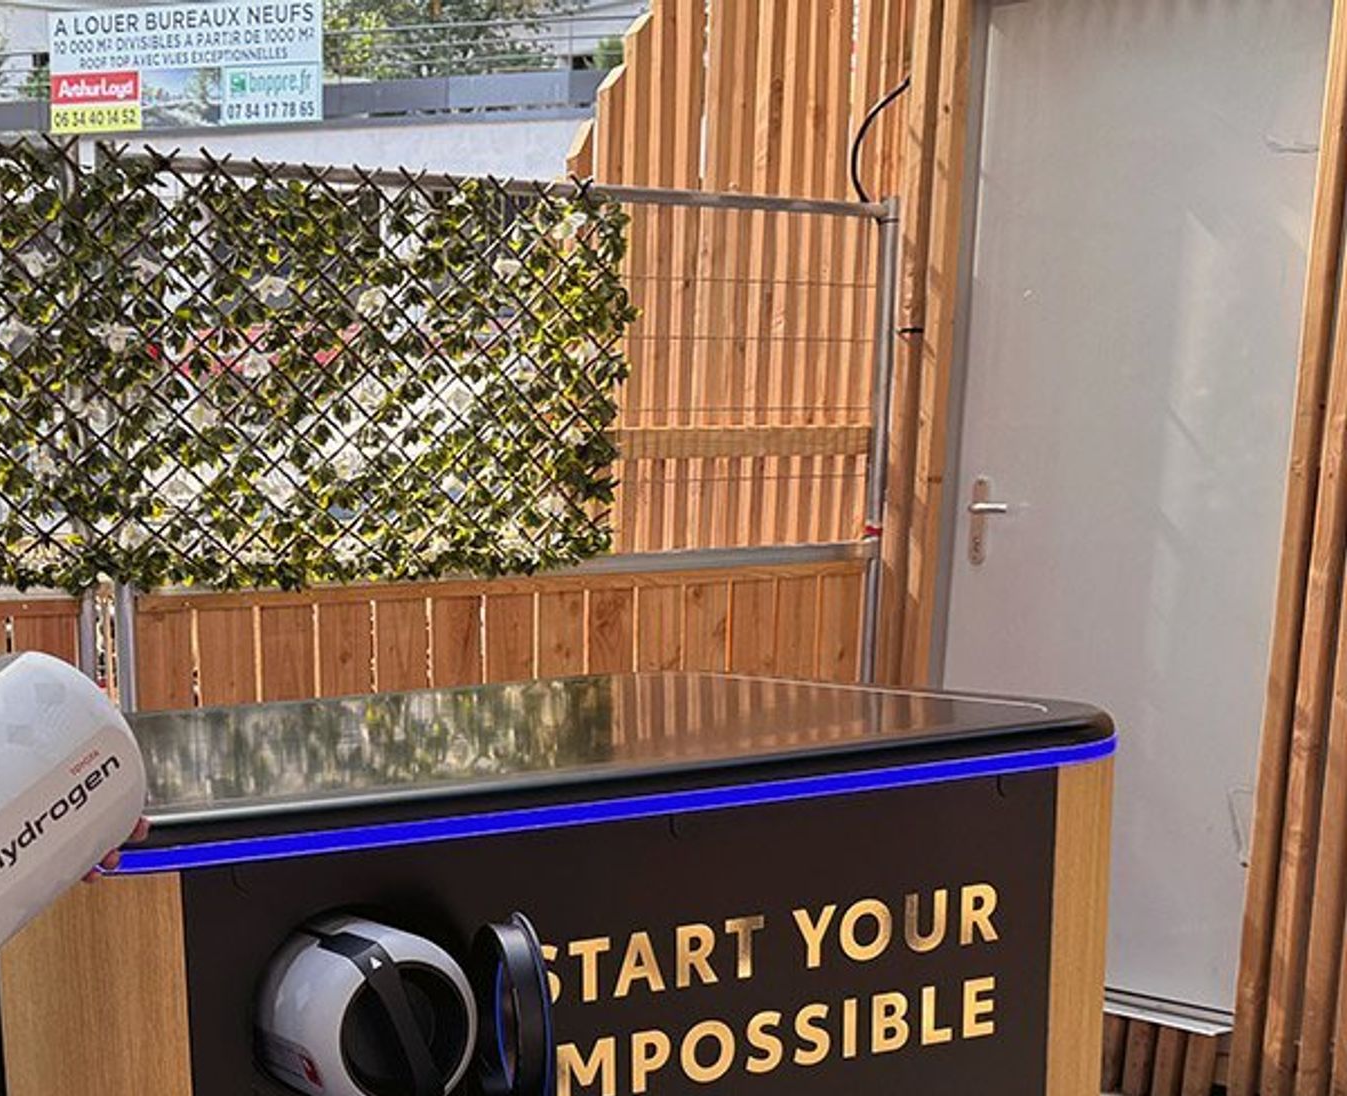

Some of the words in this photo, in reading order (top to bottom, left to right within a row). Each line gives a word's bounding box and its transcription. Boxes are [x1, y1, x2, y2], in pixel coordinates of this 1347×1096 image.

[54, 17, 68, 36] A
[73, 13, 140, 36] LOUER
[145, 7, 240, 31] BUREAUX
[246, 2, 315, 25] NEUFS
[53, 39, 67, 55] 10
[69, 38, 94, 54] 000
[115, 33, 181, 52] DIVISIBLES
[183, 33, 193, 47] A
[195, 29, 241, 46] PARTIR
[244, 28, 261, 44] DE
[264, 26, 295, 42] 1000
[132, 52, 161, 67] AVEC
[162, 51, 189, 66] VUES
[190, 46, 289, 64] EXCEPTIONNELLES
[54, 111, 69, 127] 06
[88, 109, 105, 125] 40
[106, 108, 119, 125] 14
[121, 107, 137, 125] 52
[226, 103, 242, 119] 07
[263, 102, 278, 118] 17
[282, 101, 297, 118] 78
[791, 883, 999, 969] YOUR
